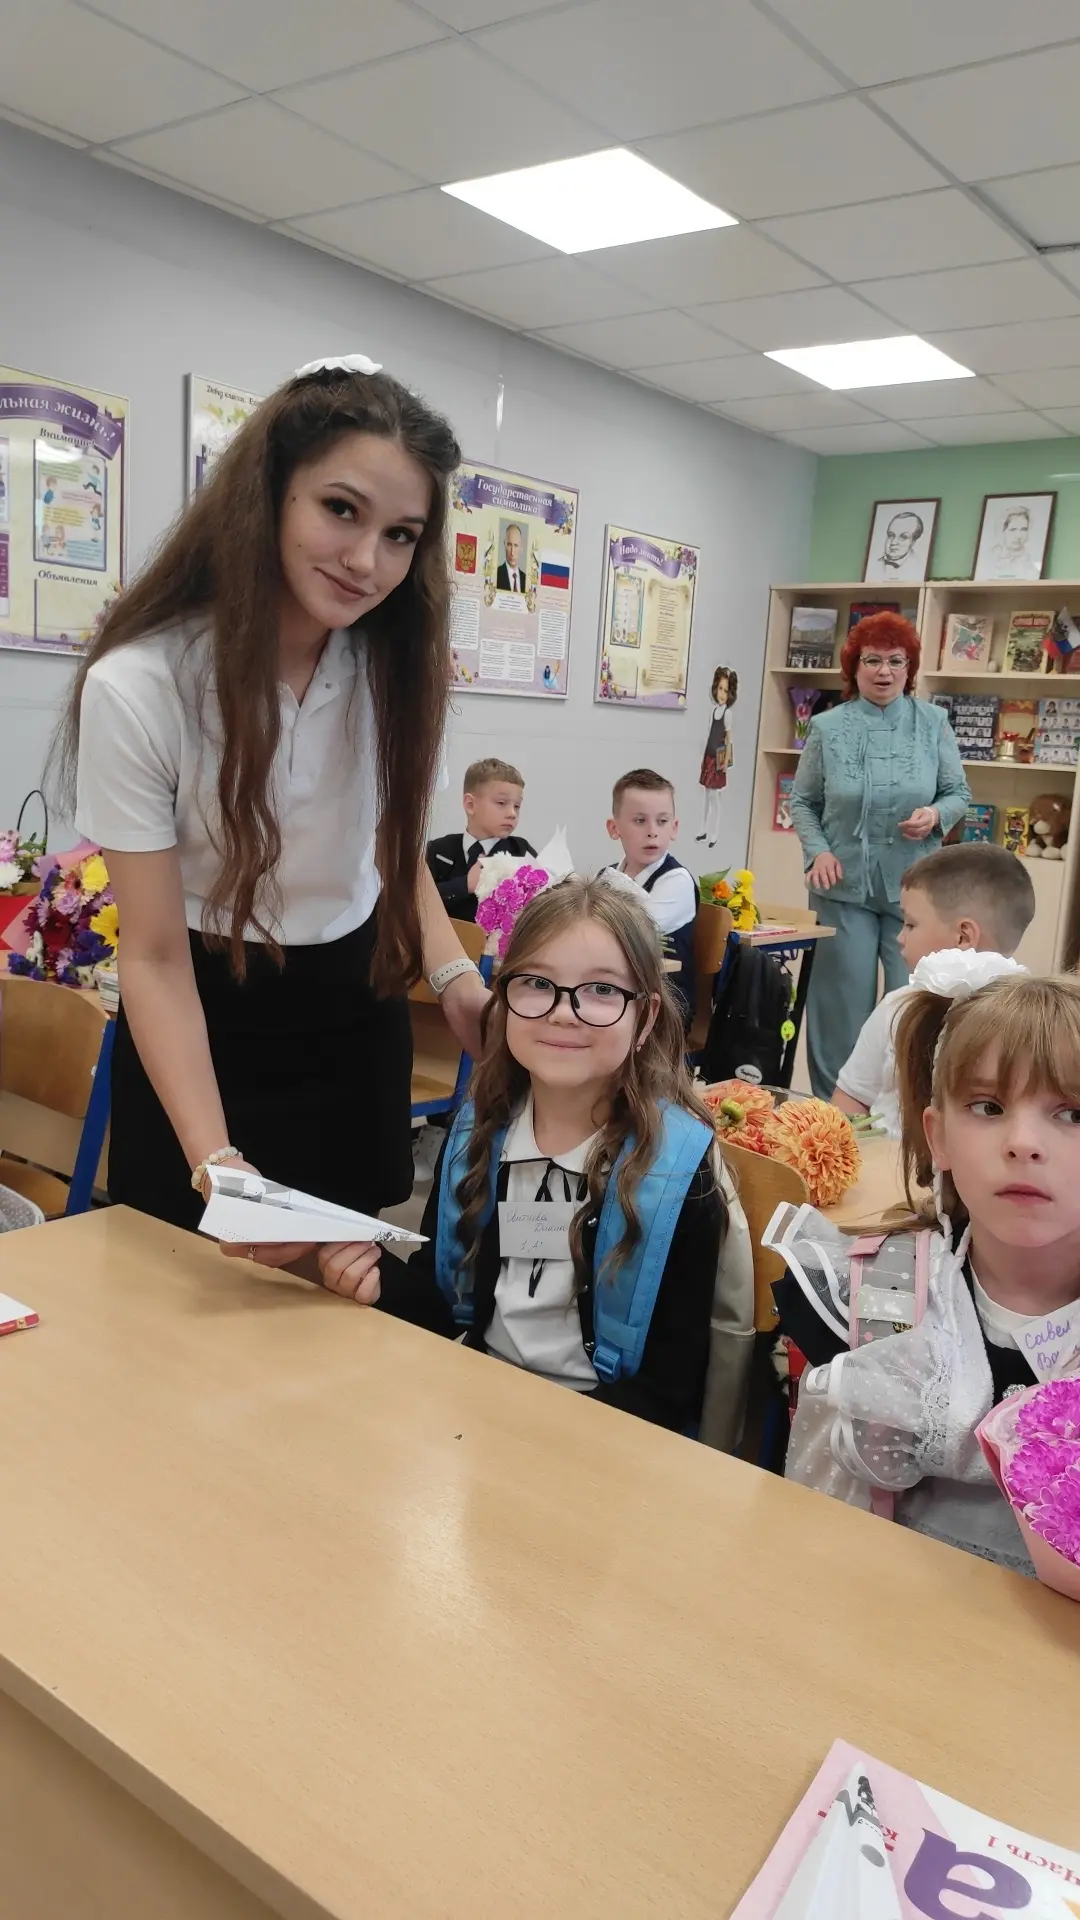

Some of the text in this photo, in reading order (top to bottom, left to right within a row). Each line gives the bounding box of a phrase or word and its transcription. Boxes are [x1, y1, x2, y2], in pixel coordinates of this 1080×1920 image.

[54, 402, 116, 441] жизнь!
[477, 478, 553, 507] Государственная
[492, 496, 538, 514] символика
[38, 569, 98, 586] Объявления
